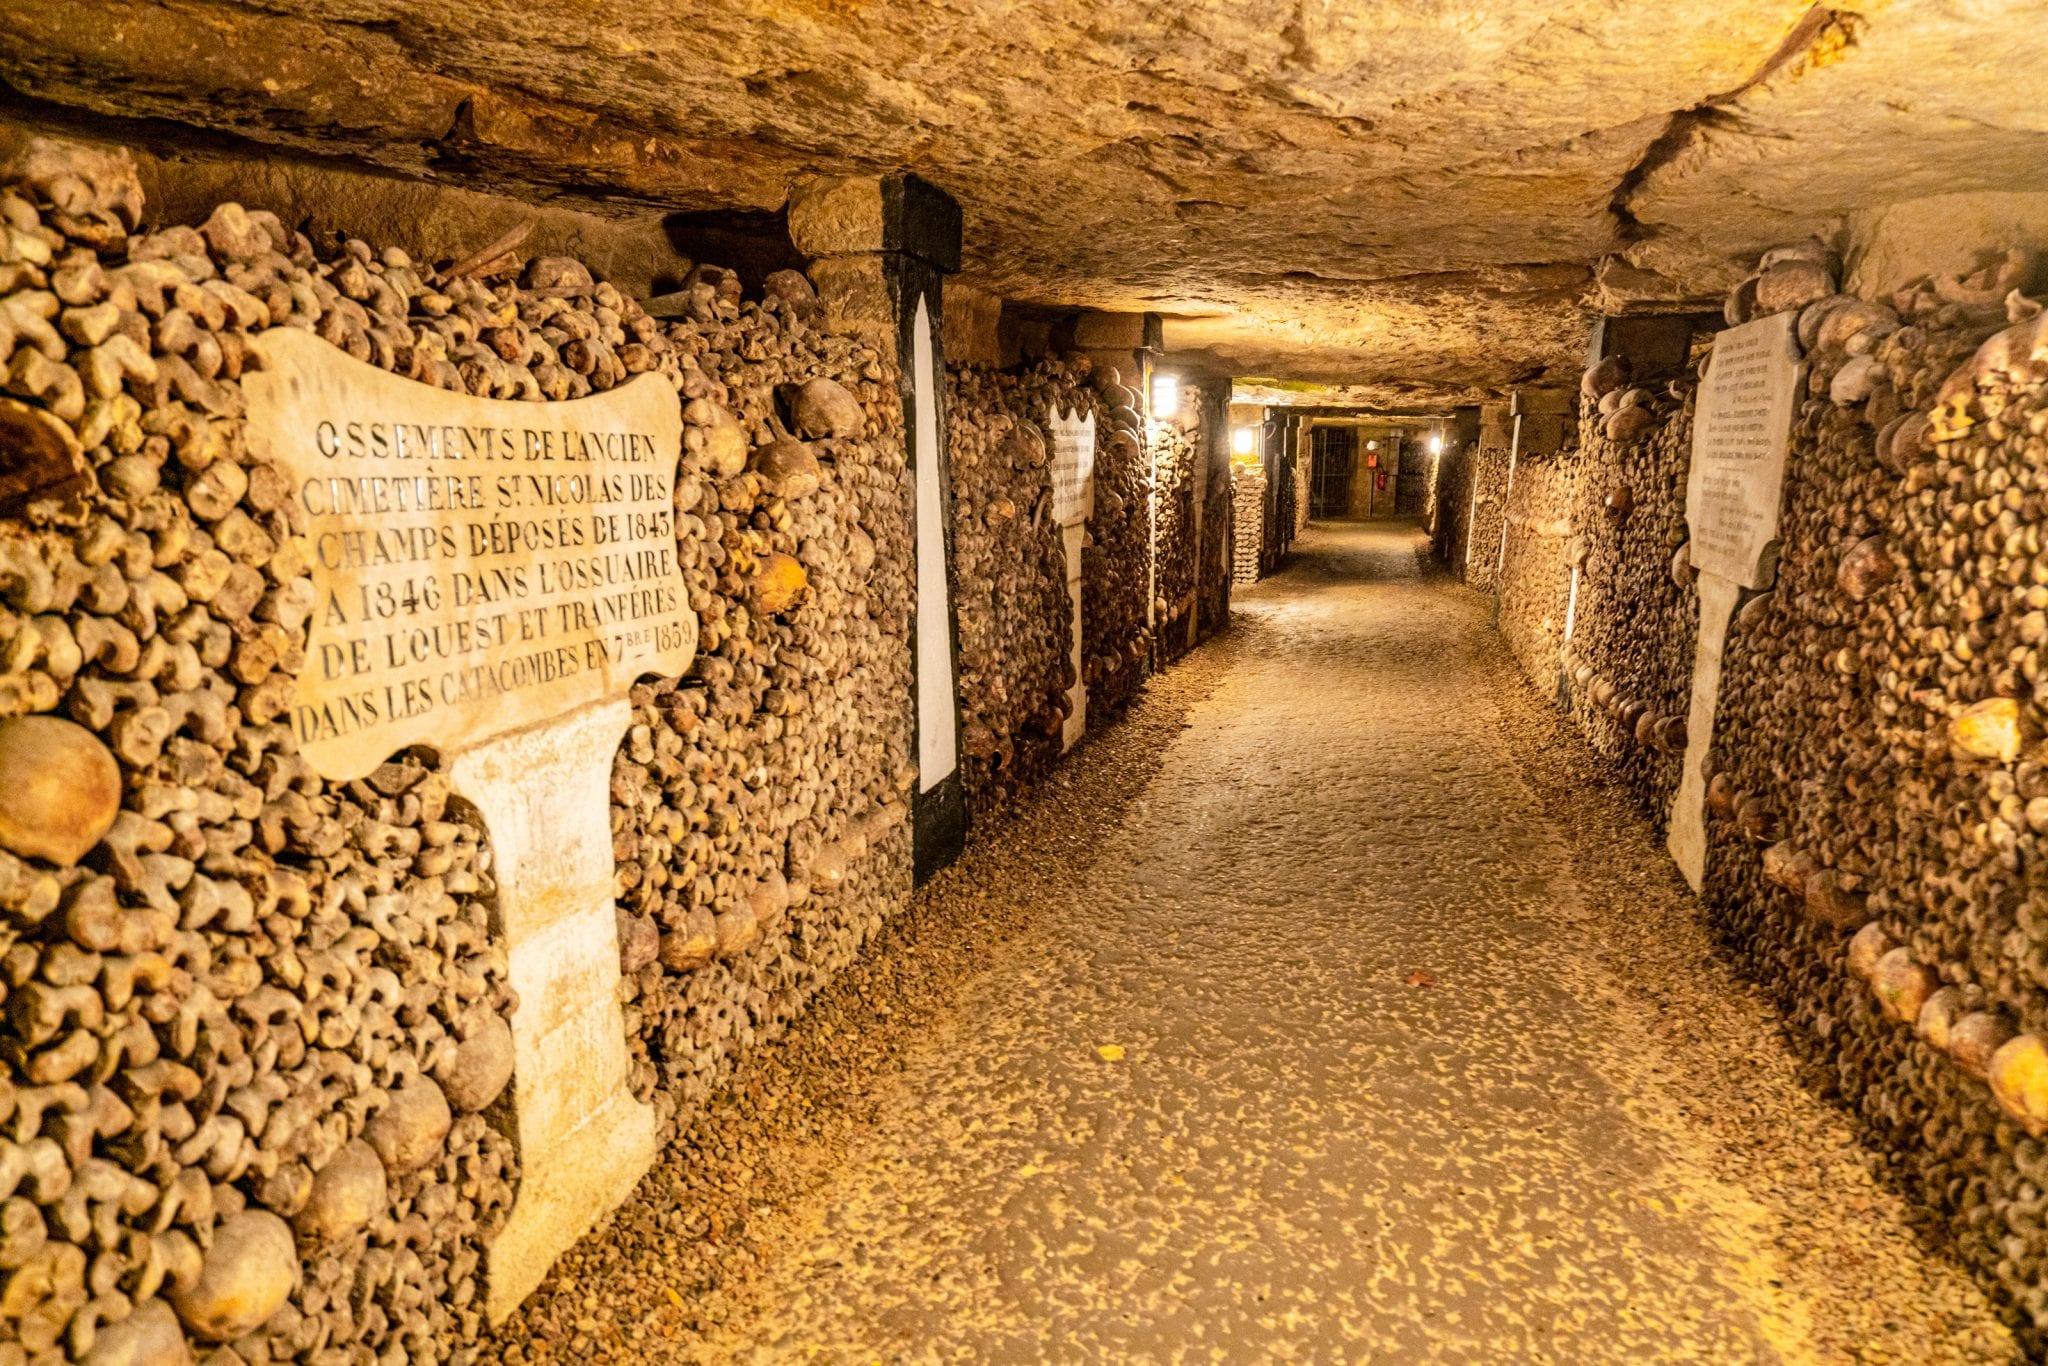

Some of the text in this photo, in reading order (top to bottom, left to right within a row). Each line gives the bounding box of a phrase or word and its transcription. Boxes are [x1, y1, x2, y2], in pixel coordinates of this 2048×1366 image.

[316, 420, 657, 462] OSSEMENTS DE L'ANCIEN
[302, 465, 486, 516] CIMETIÈRE
[526, 474, 624, 505] NICOLAS
[630, 474, 667, 502] DES
[317, 525, 457, 570] CHAMPS
[467, 508, 585, 557] DÉPOSÉS
[592, 514, 621, 545] DE
[323, 549, 672, 627] A 1846 DANS L'OSSUAIRE
[320, 581, 677, 682] DE L'OUEST ET TRANFÉRÉS
[297, 689, 379, 744] DANS
[385, 676, 434, 723] LES
[440, 645, 579, 706] CATACOMBES
[585, 638, 609, 670] EN
